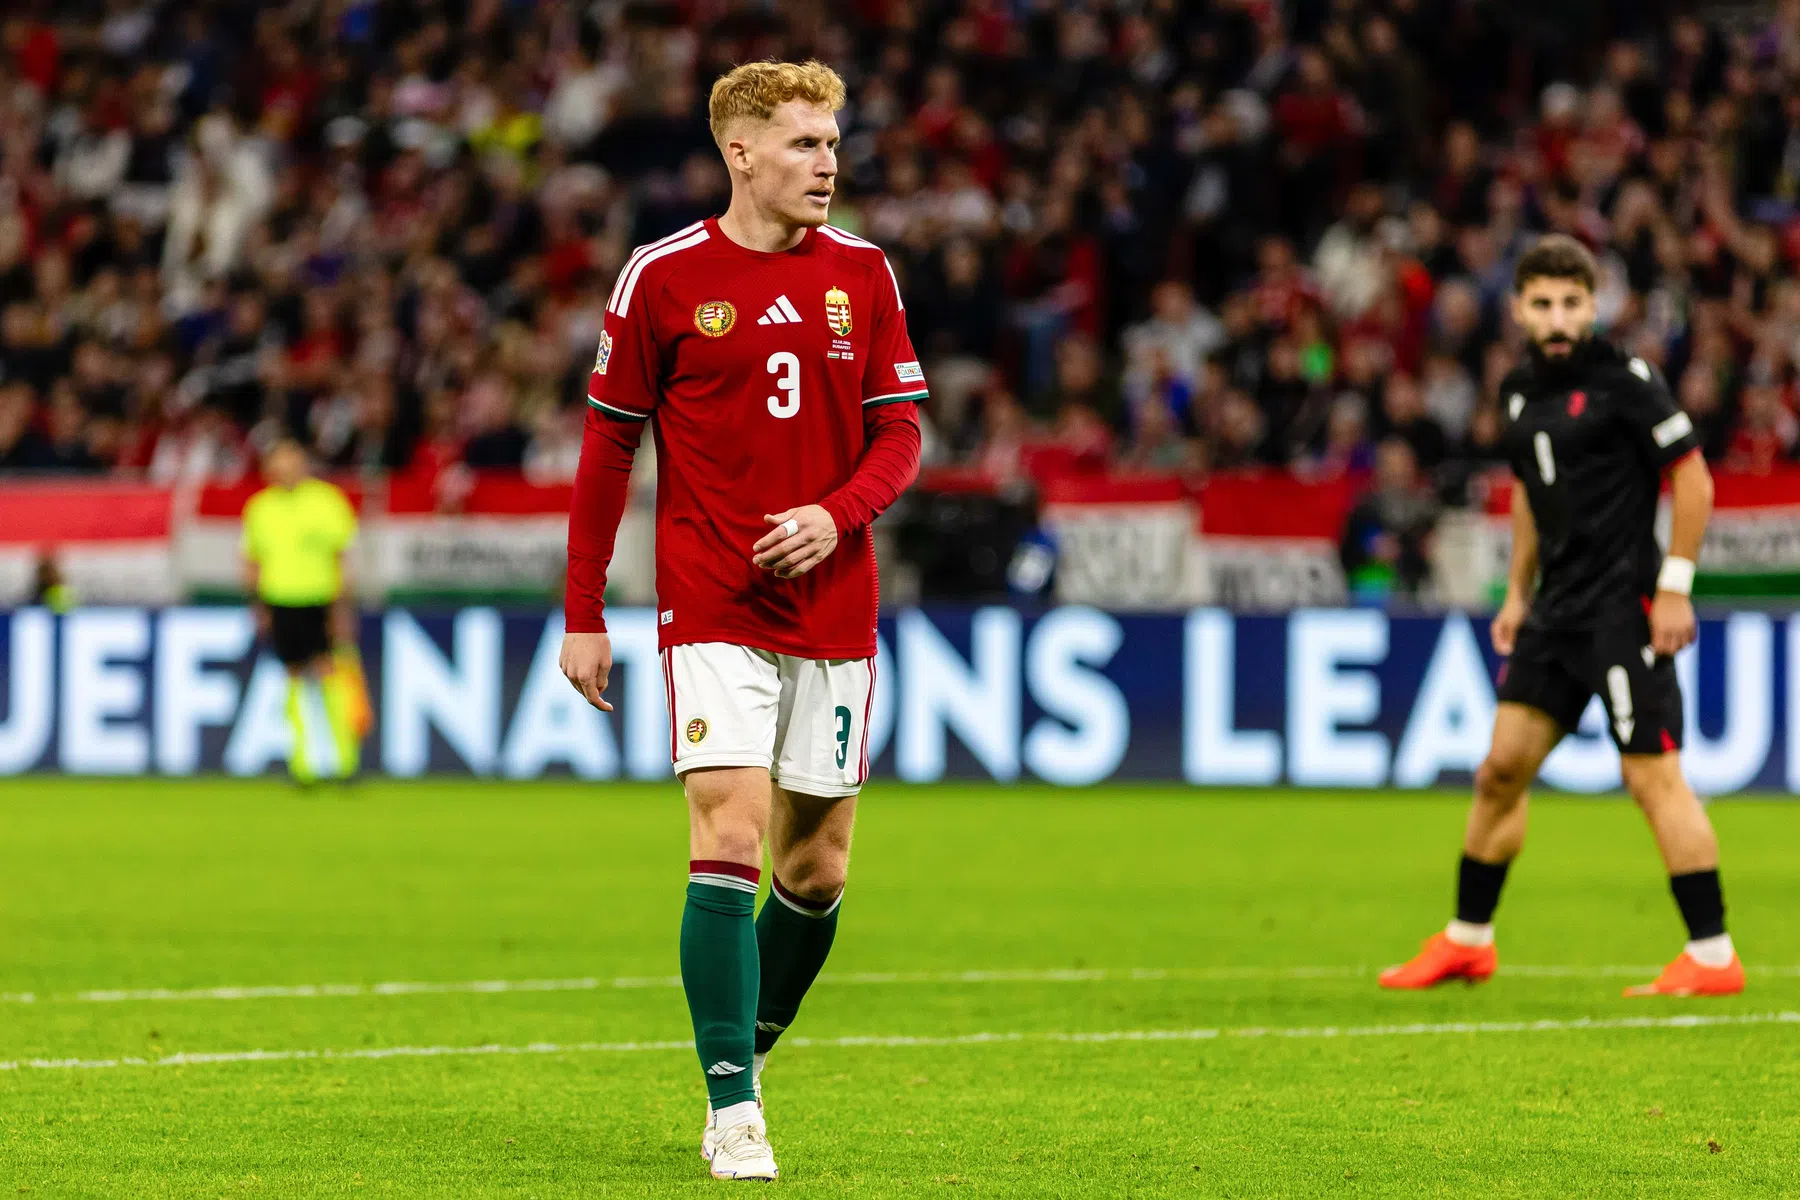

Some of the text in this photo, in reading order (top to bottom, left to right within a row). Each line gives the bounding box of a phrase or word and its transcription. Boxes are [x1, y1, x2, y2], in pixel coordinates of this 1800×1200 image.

[766, 351, 801, 419] 3
[381, 604, 1131, 787] NATNS
[1182, 605, 1800, 796] LEAU
[834, 705, 852, 770] 3
